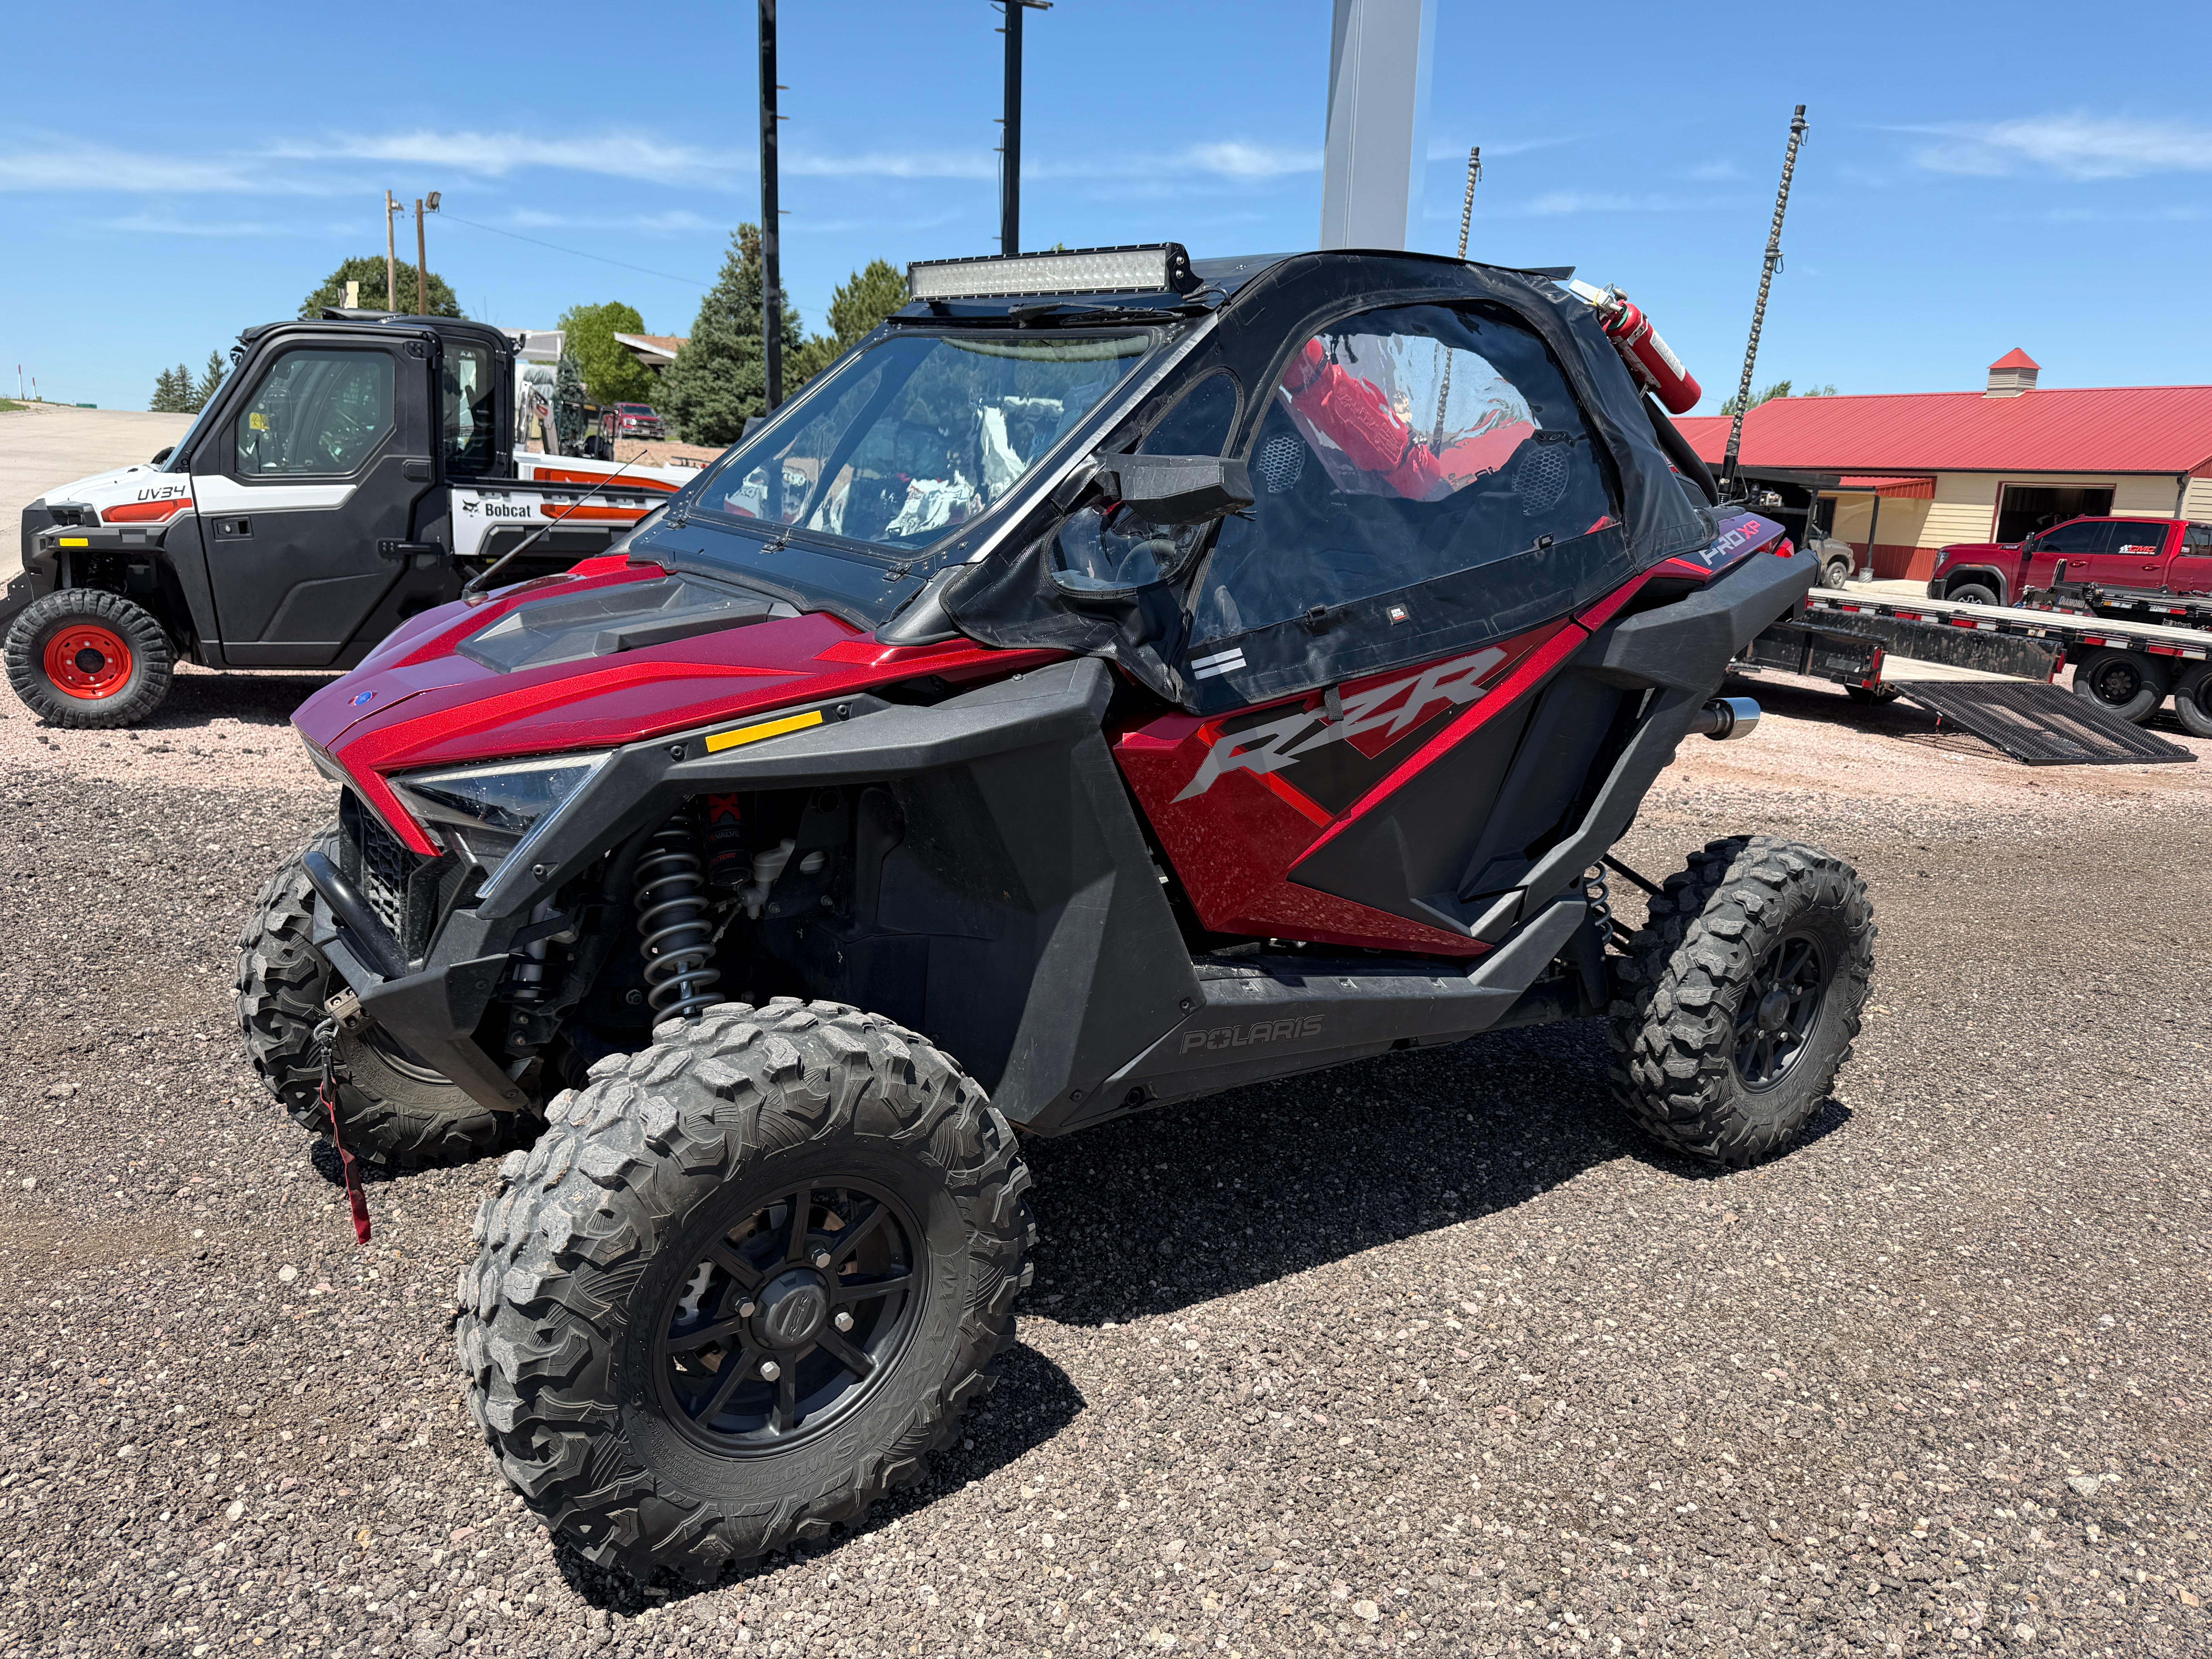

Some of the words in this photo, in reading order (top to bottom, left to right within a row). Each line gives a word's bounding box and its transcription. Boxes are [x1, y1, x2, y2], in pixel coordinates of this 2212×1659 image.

[137, 485, 185, 500] UV34
[486, 503, 531, 517] Bobcat
[1698, 530, 1746, 565] PRO
[1737, 520, 1761, 539] XP
[2058, 595, 2085, 608] DIAMOND
[2172, 621, 2192, 629] Bobcat
[1170, 647, 1507, 804] RZR
[1179, 1014, 1325, 1055] POLARIS
